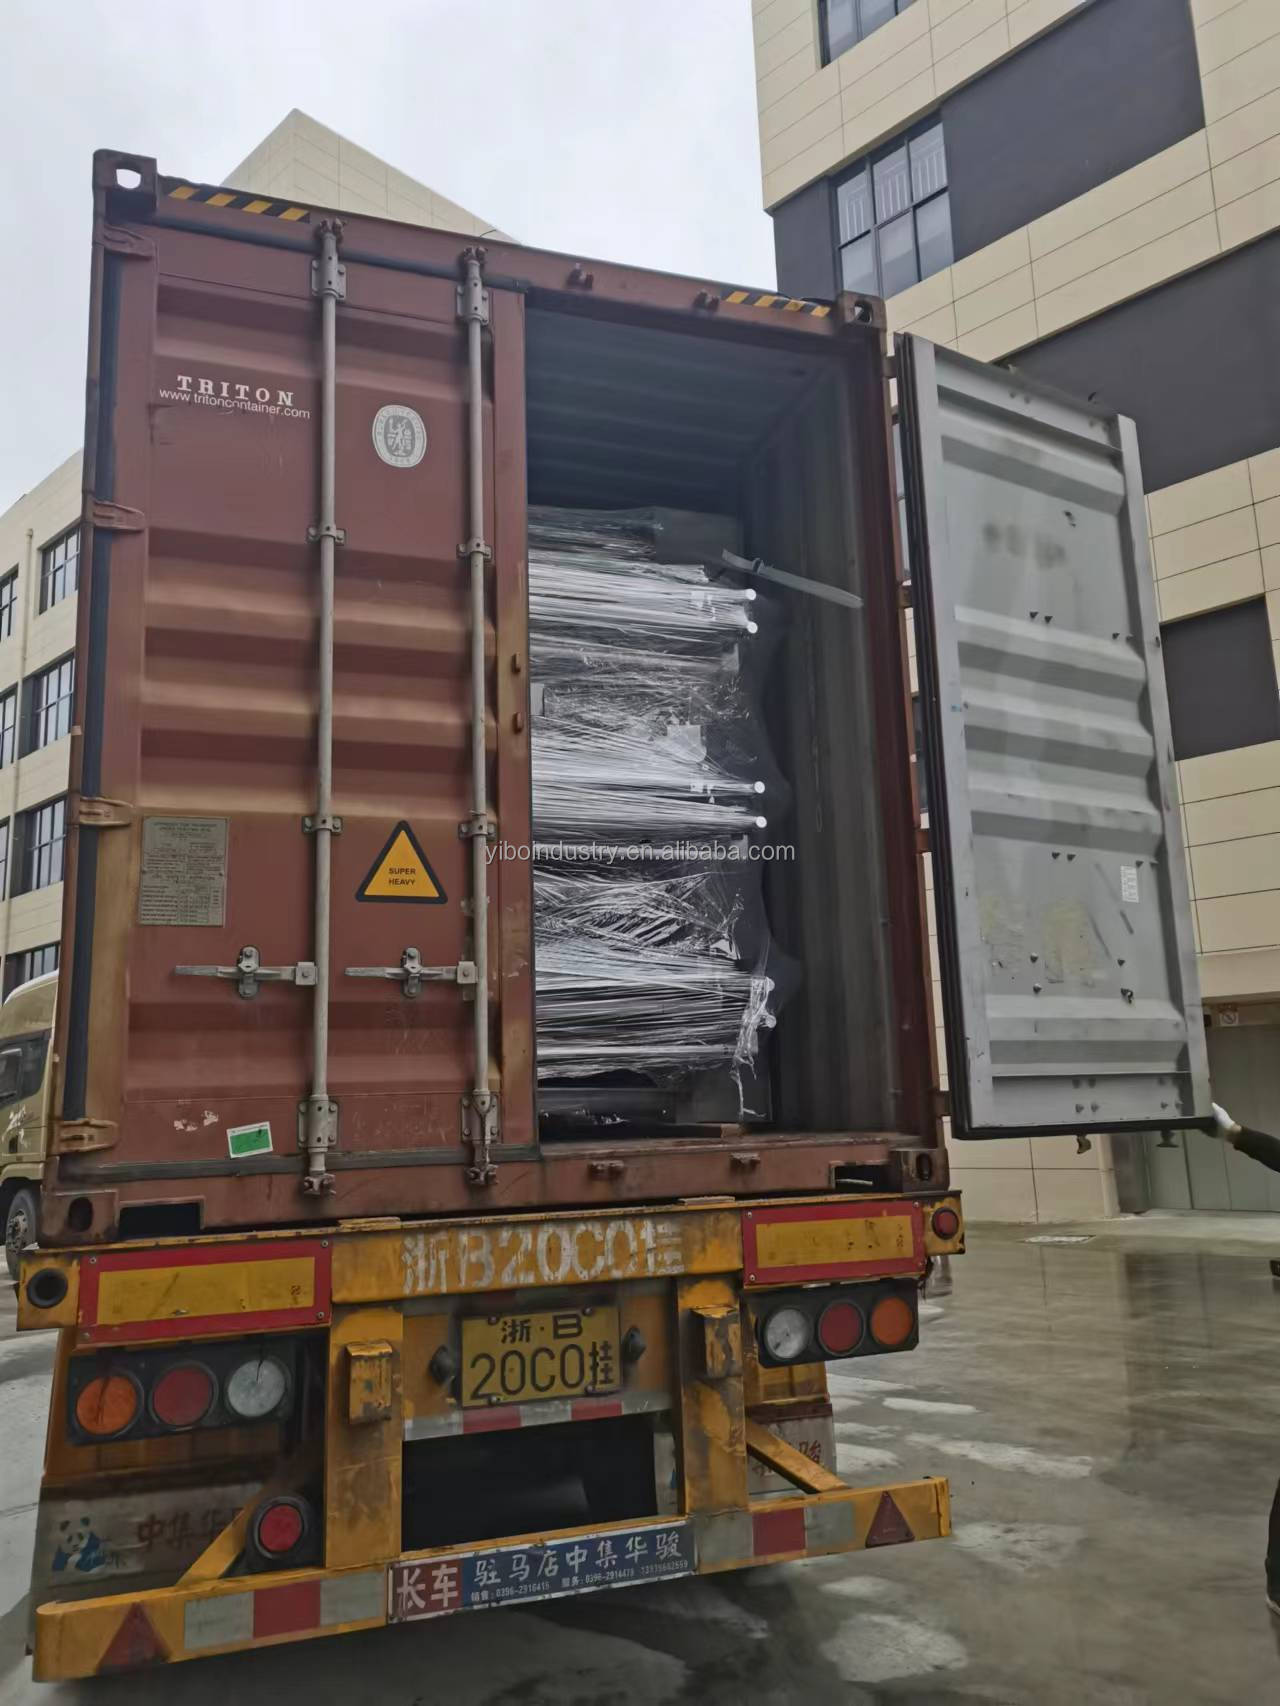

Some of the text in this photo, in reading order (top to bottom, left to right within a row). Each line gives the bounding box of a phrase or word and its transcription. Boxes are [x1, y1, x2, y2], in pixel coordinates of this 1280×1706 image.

[176, 375, 294, 406] TRITON
[388, 867, 416, 876] SUPER
[388, 878, 416, 886] HEAVY
